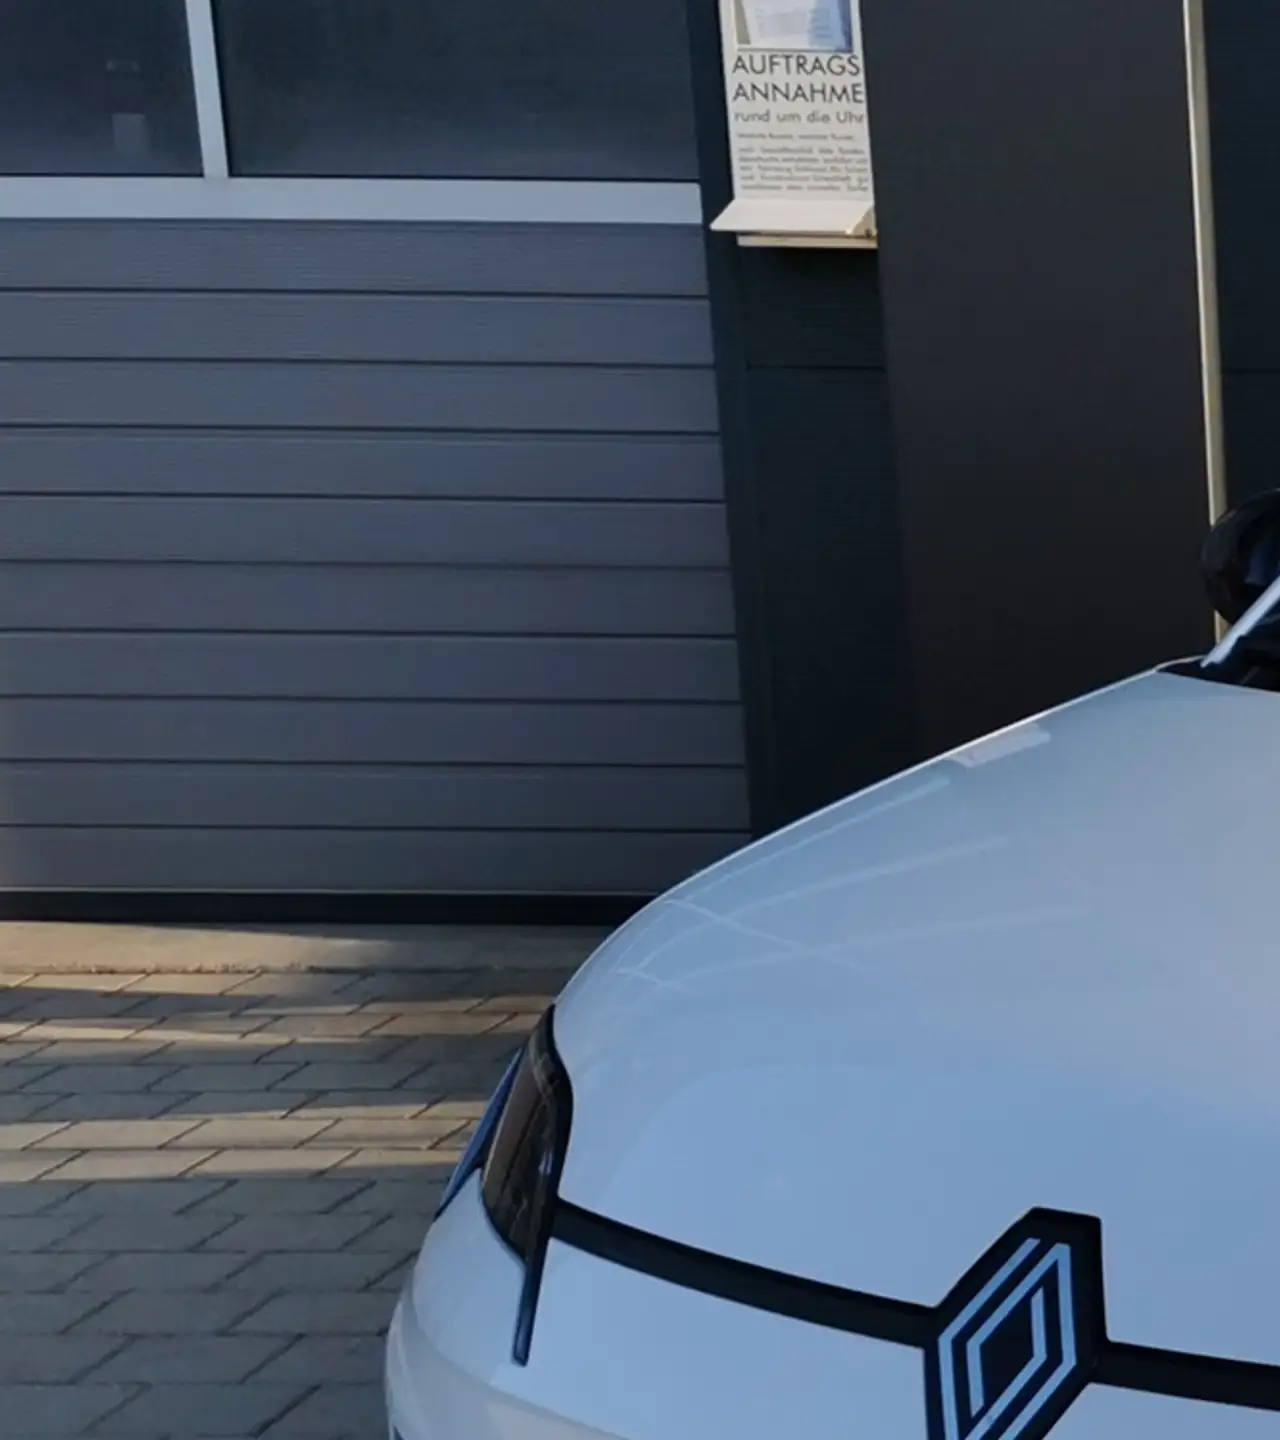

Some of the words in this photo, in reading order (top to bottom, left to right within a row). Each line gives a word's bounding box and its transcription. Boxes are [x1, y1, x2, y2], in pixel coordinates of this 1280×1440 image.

[732, 54, 861, 76] AUFTRAGS
[732, 83, 864, 103] ANNAHME
[734, 110, 770, 123] rund
[776, 114, 801, 123] um
[806, 110, 830, 124] die
[836, 111, 864, 124] Uhr
